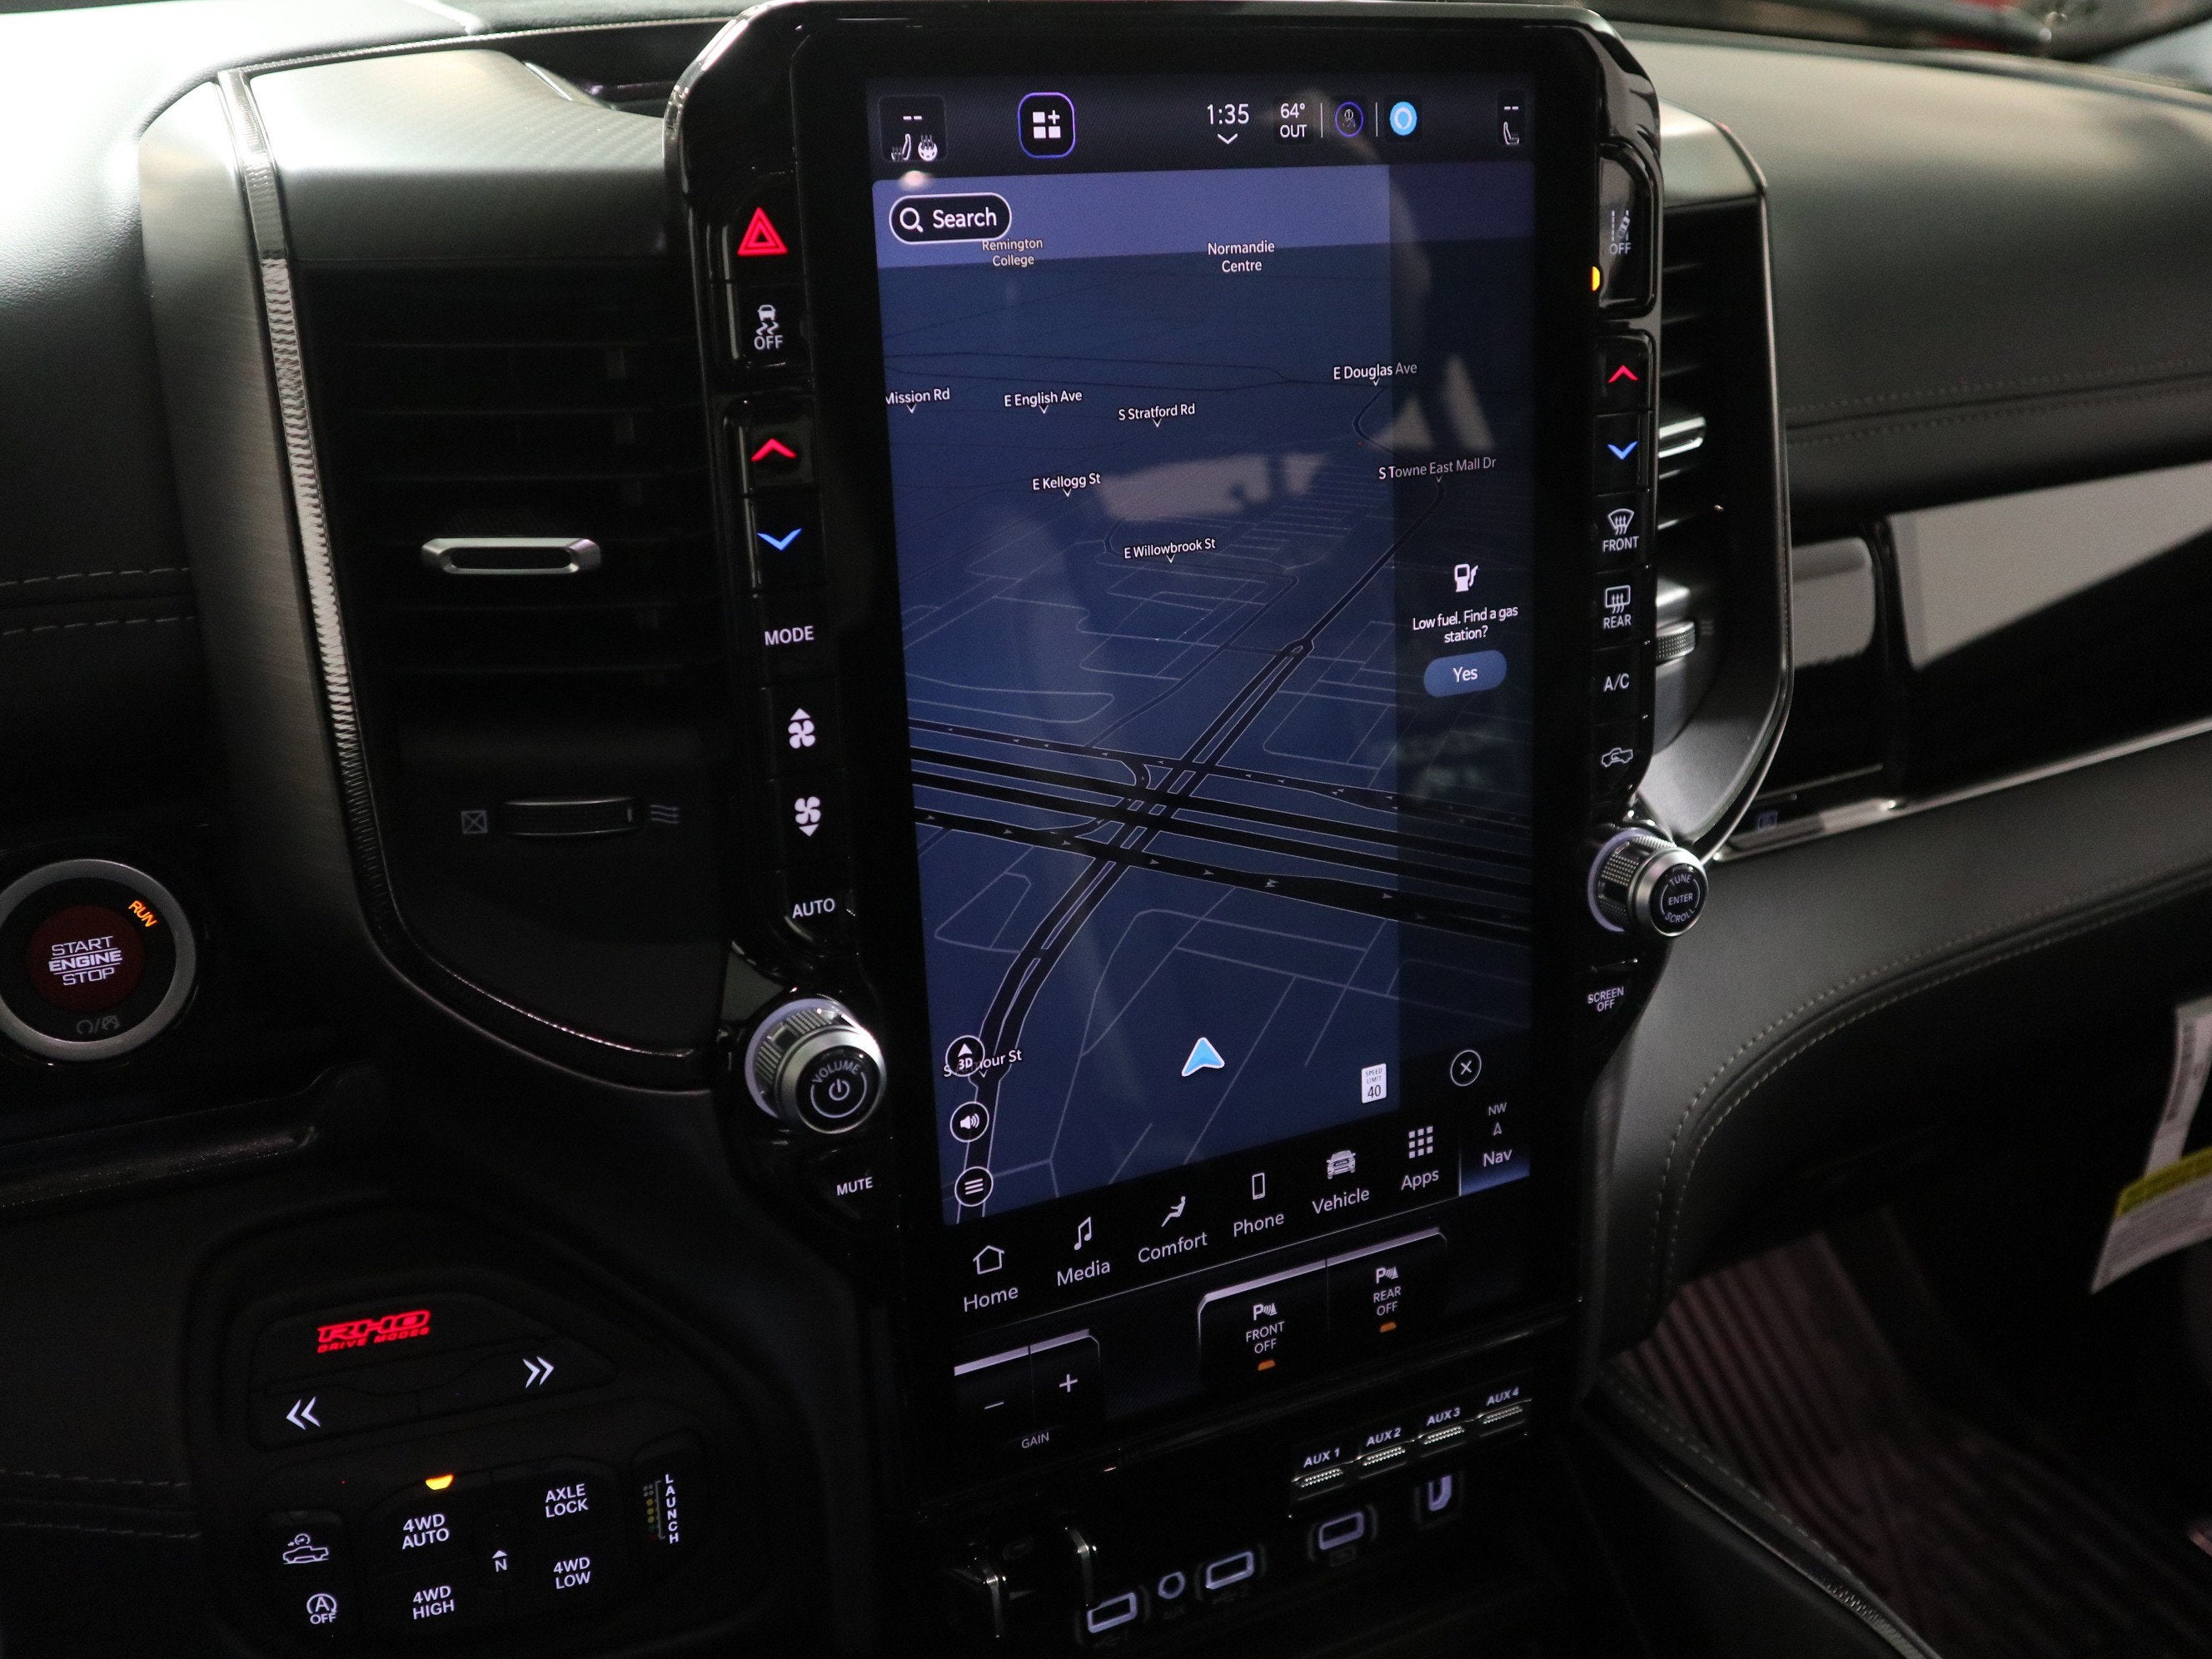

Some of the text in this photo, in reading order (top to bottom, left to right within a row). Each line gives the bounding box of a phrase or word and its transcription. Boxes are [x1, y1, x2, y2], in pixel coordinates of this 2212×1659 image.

[1208, 103, 1249, 125] 1:35
[1280, 124, 1308, 138] OUT
[933, 207, 997, 229] Search
[982, 238, 1044, 252] Remington
[1207, 240, 1275, 255] Normandie
[1609, 242, 1632, 255] OFF
[992, 254, 1034, 267] College
[1222, 259, 1263, 272] Centre
[754, 335, 784, 351] OFF
[1333, 361, 1418, 380] E Douglas Ave
[934, 387, 950, 401] Rd
[1004, 390, 1083, 407] E English Ave
[1118, 403, 1196, 421] S Stratford Rd
[1378, 456, 1497, 480] S Towne East Mall Dr
[1033, 472, 1101, 491] E Kellogg St
[1123, 538, 1216, 559] E Willowbrook St
[1602, 536, 1640, 553] FRONT
[1412, 606, 1518, 630] Low fuel. Find a gas
[1603, 615, 1632, 630] REAR
[764, 625, 815, 646] MODE
[1444, 625, 1489, 644] station?
[1452, 666, 1478, 682] Yes
[1603, 673, 1630, 692] A/C
[1669, 874, 1693, 887] TUNE
[791, 898, 836, 919] AUTO
[1667, 893, 1694, 906] ENTER
[128, 899, 159, 928] RUN
[1664, 908, 1696, 924] SCROLL
[51, 935, 114, 956] START
[48, 949, 123, 973] ENGINE
[62, 967, 115, 986] STOP
[1587, 986, 1624, 1004] SCREEN
[1597, 999, 1616, 1013] OFF
[811, 1059, 862, 1084] VOLUME
[944, 1064, 952, 1078] S
[1009, 1049, 1022, 1063] St
[958, 1058, 973, 1070] 3D
[1365, 1068, 1382, 1077] SPEED
[1368, 1084, 1382, 1099] 40
[1487, 1102, 1508, 1117] NW
[1482, 1149, 1513, 1168] Nav
[836, 1177, 874, 1196] MUTE
[1400, 1168, 1440, 1191] Apps
[1312, 1188, 1370, 1214] Vehicle
[1233, 1212, 1285, 1238] Phone
[1138, 1232, 1208, 1263] Comfort
[1057, 1259, 1111, 1287] Media
[963, 1286, 1019, 1313] Home
[1373, 1286, 1402, 1303] REAR
[1376, 1301, 1398, 1317] OFF
[316, 1327, 431, 1353] DRIVE MODES
[1245, 1320, 1285, 1343] FRONT
[1253, 1338, 1278, 1354] OFF
[1021, 1432, 1050, 1449] GAIN
[545, 1483, 586, 1503] AXLE
[545, 1497, 590, 1518] LOCK
[665, 1473, 680, 1545] LAUNCH
[403, 1513, 446, 1532] 4WD
[401, 1527, 450, 1550] AUTO
[495, 1559, 508, 1572] N
[553, 1557, 590, 1575] 4WD
[555, 1571, 591, 1590] LOW
[412, 1586, 451, 1604] 4WD
[309, 1612, 337, 1625] OFF
[412, 1599, 456, 1620] HIGH
